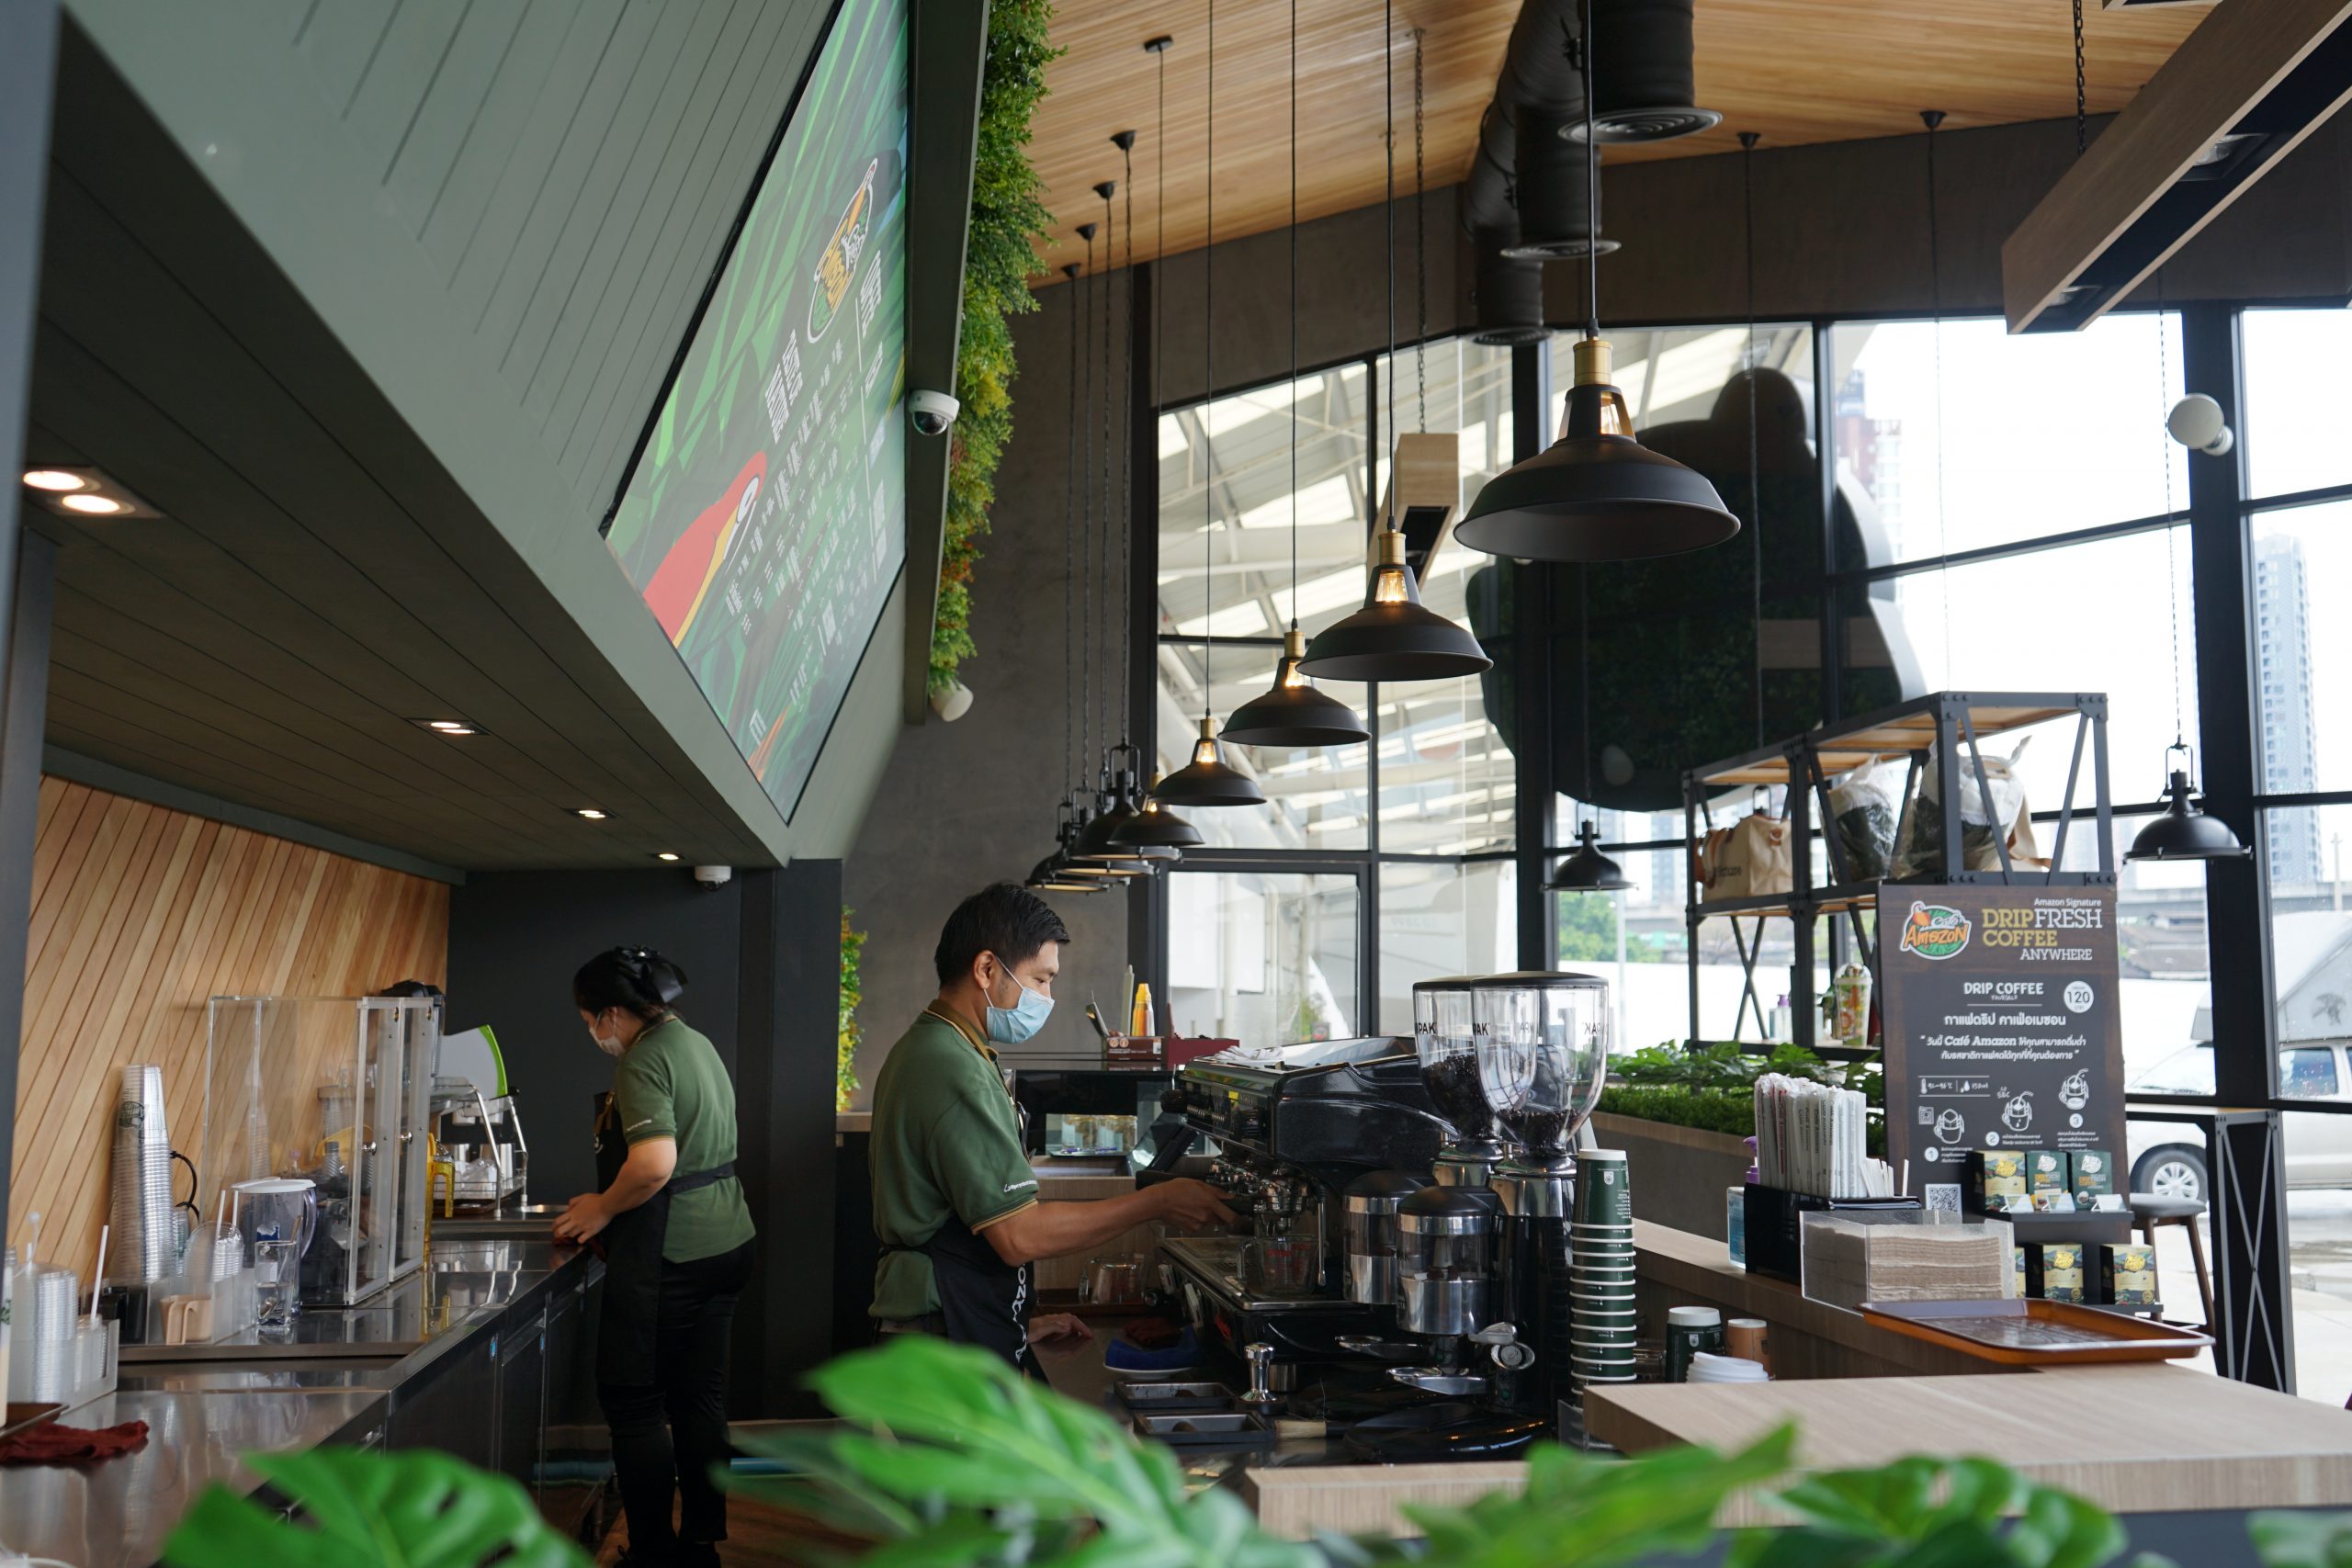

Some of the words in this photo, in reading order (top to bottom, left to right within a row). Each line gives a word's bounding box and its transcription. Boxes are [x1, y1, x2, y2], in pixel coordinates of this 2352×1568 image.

[2033, 897, 2065, 907] Amazon
[2066, 897, 2102, 908] Signature
[1983, 930, 2058, 947] COFFEE
[2019, 948, 2093, 961] ANYWHERE
[1963, 982, 1993, 995] DRIP
[1996, 982, 2044, 995] COFFEE
[2067, 991, 2090, 1004] 120
[1944, 1035, 1971, 1046] Café
[1972, 1035, 2017, 1046] Amazon
